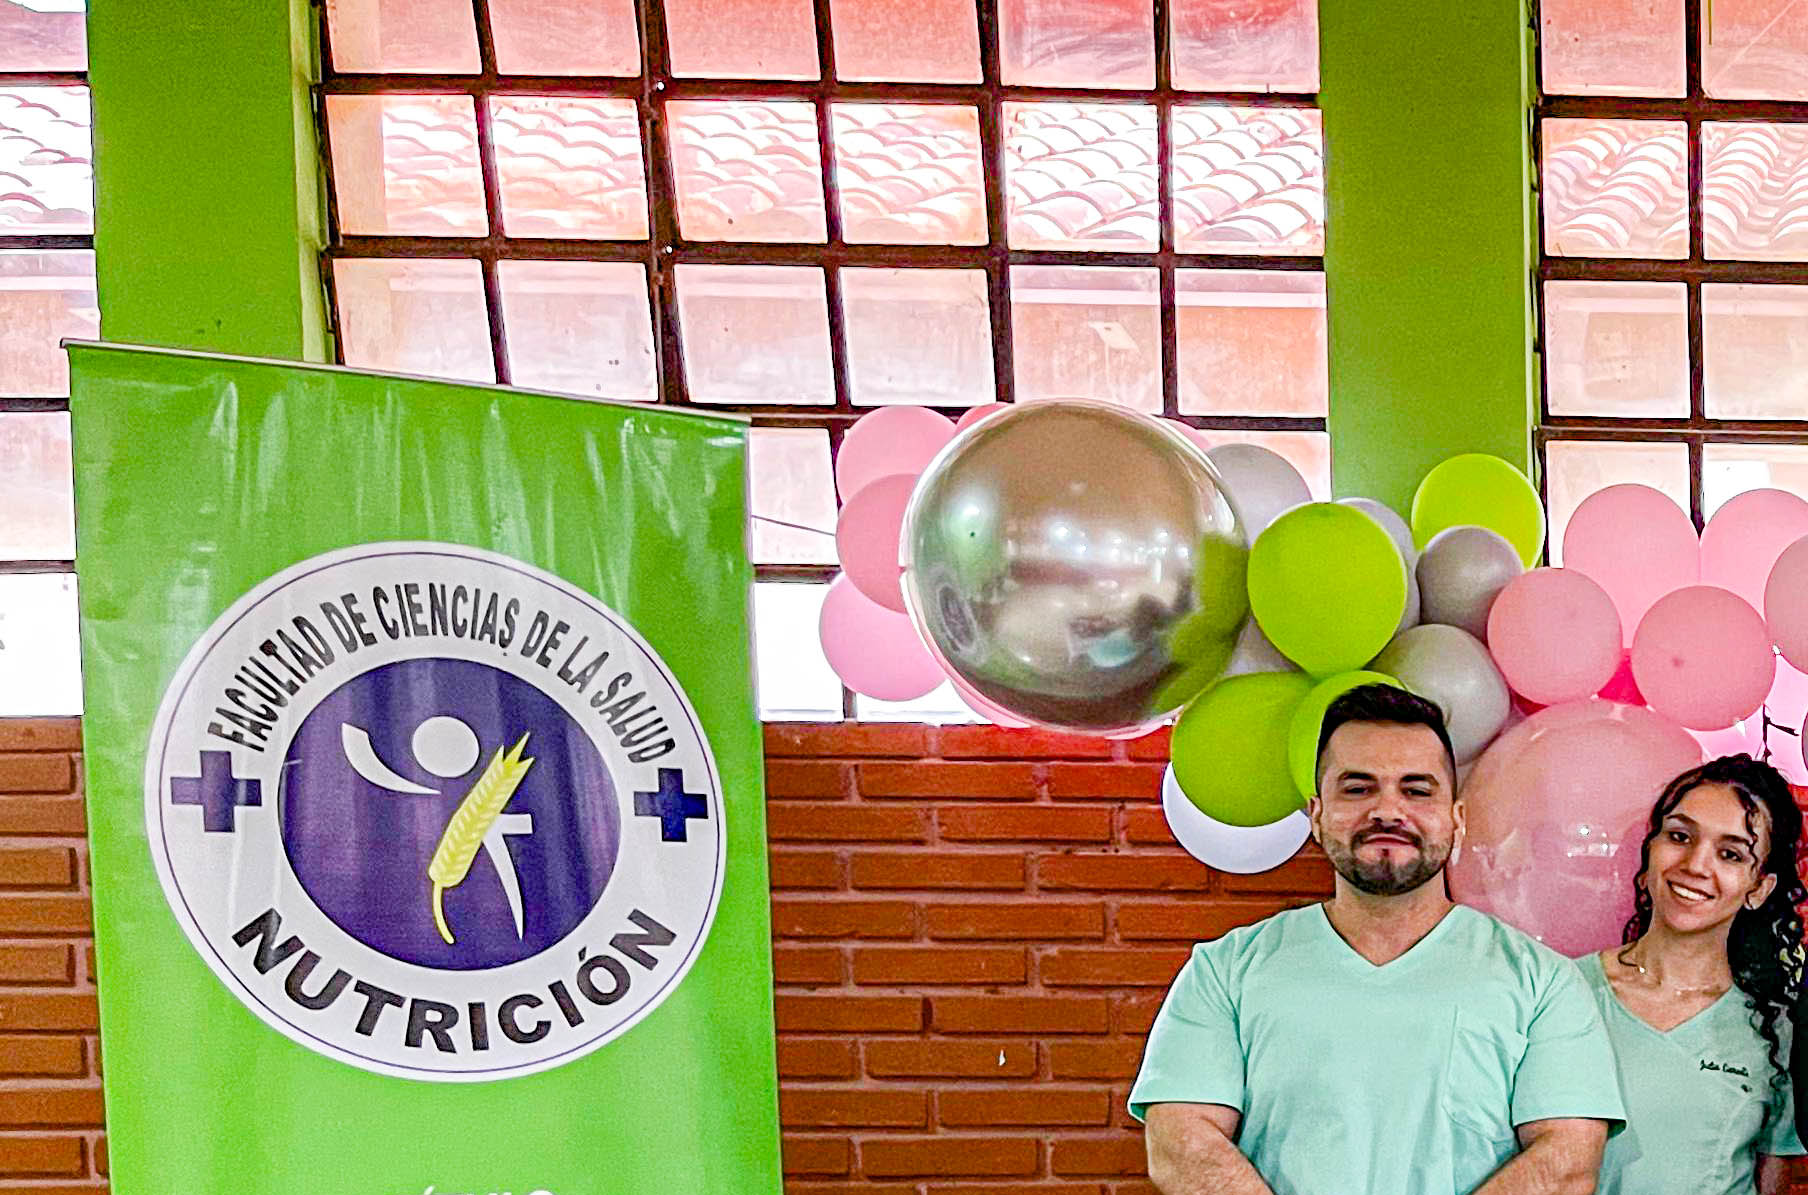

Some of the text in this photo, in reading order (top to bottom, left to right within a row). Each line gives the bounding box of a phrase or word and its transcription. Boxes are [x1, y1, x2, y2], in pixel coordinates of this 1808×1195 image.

[208, 582, 676, 764] FACULTAD DE CIENCIAS DE LA SALUD
[231, 907, 677, 1053] NUTRICIÓN
